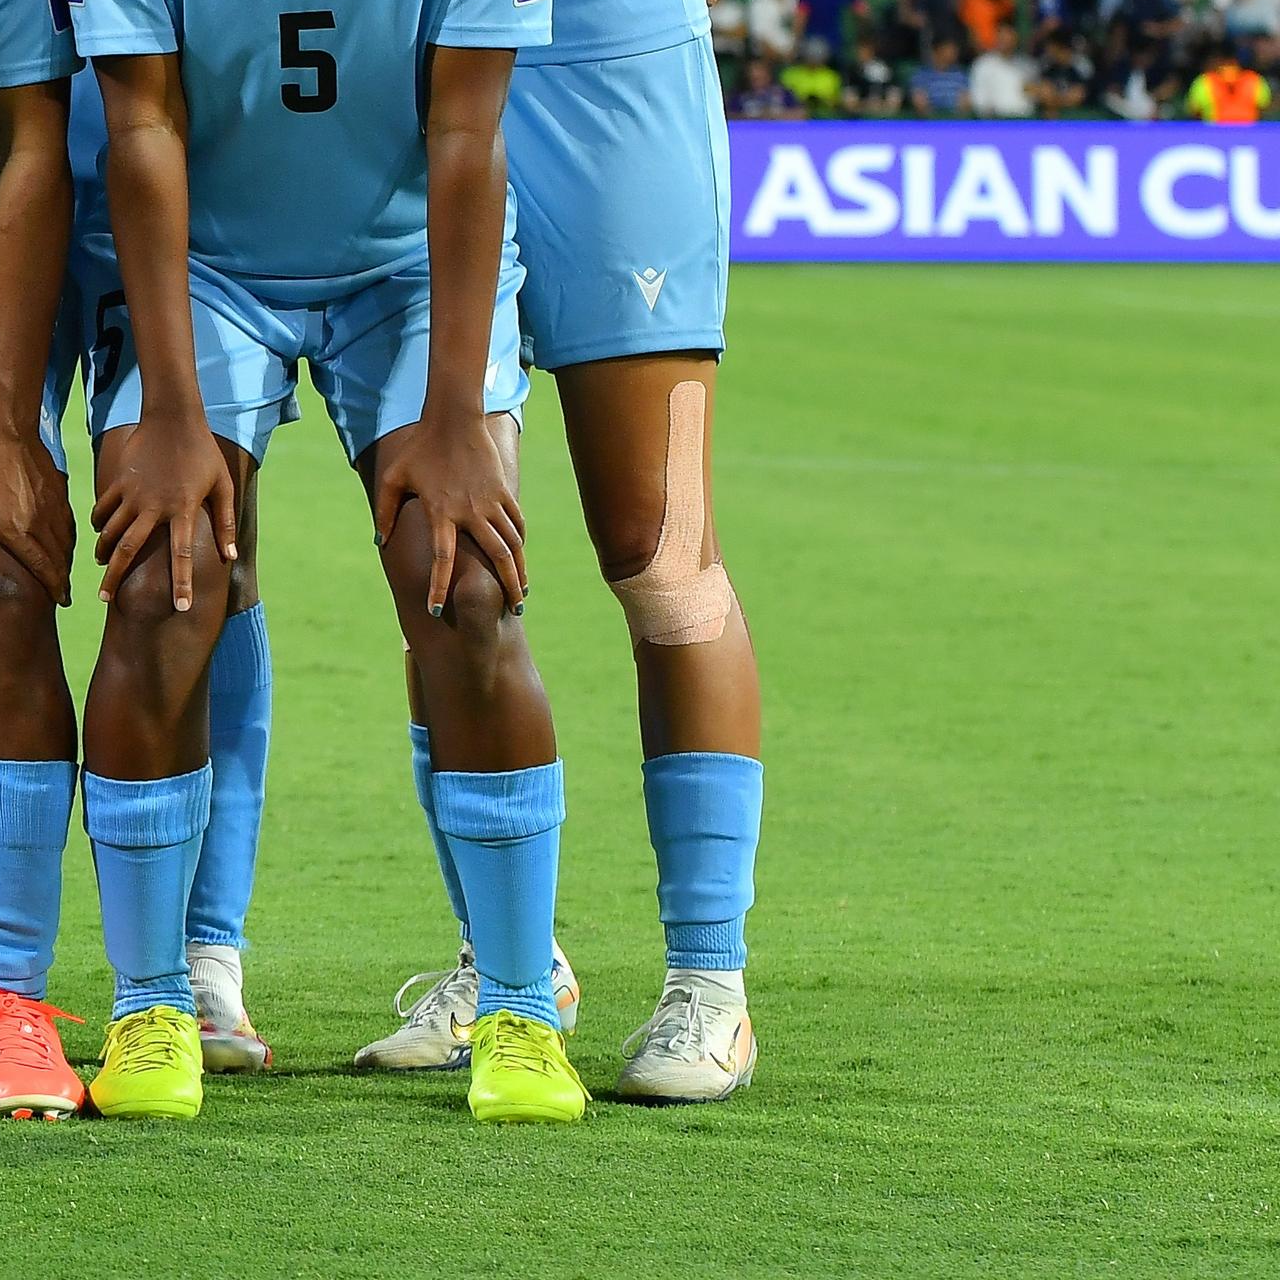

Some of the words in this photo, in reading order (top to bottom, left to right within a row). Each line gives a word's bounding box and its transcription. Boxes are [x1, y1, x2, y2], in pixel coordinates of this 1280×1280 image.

[279, 9, 338, 113] 5
[743, 144, 1120, 238] ASIAN
[1139, 144, 1280, 240] CU
